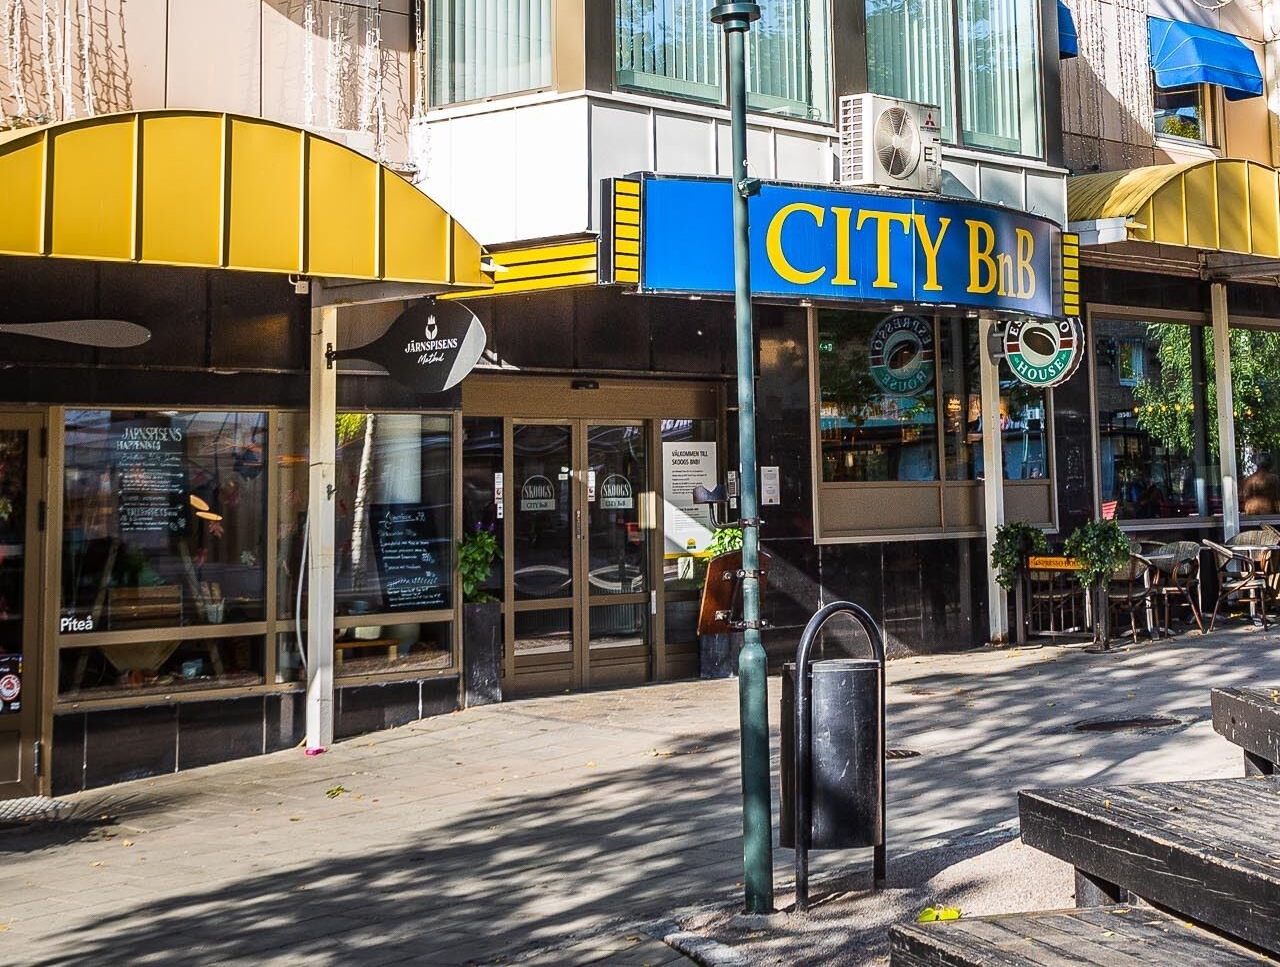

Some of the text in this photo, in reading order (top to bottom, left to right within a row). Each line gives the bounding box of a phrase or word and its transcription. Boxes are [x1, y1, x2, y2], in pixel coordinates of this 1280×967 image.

[765, 202, 1036, 300] CITY BnB
[404, 338, 458, 353] JÄRNSPISENS
[1016, 358, 1065, 381] HOUSE
[524, 485, 552, 499] SKOOGS
[602, 483, 629, 498] SKOOGS
[60, 615, 93, 633] Piteå
